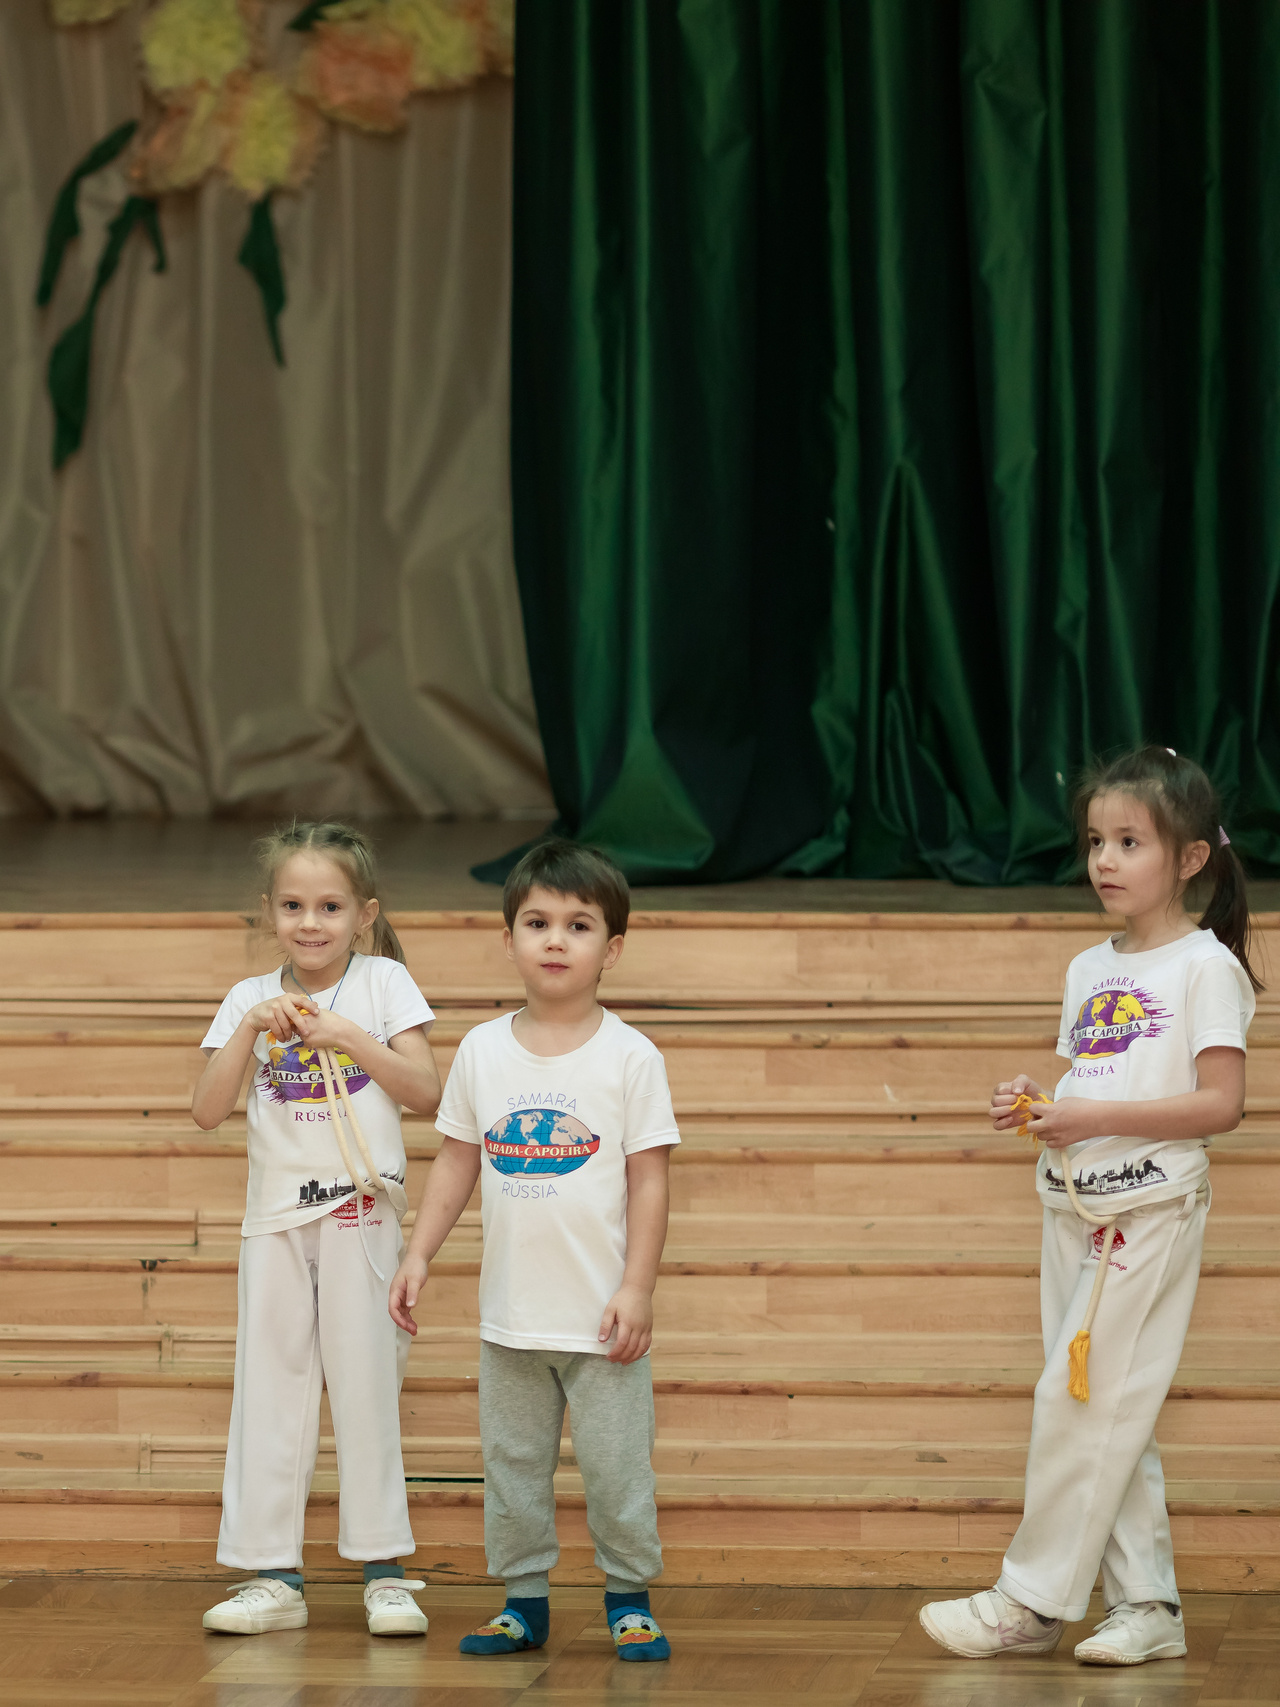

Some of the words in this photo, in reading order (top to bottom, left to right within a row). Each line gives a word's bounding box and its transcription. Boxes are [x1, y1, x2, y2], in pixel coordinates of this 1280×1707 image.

[1091, 976, 1136, 993] SAMARA
[1070, 1065, 1115, 1078] RÚSSIA
[507, 1092, 577, 1113] SAMARA
[487, 1142, 591, 1157] ABADÁ-CAPOEIRA
[501, 1180, 559, 1199] RÚSSIA
